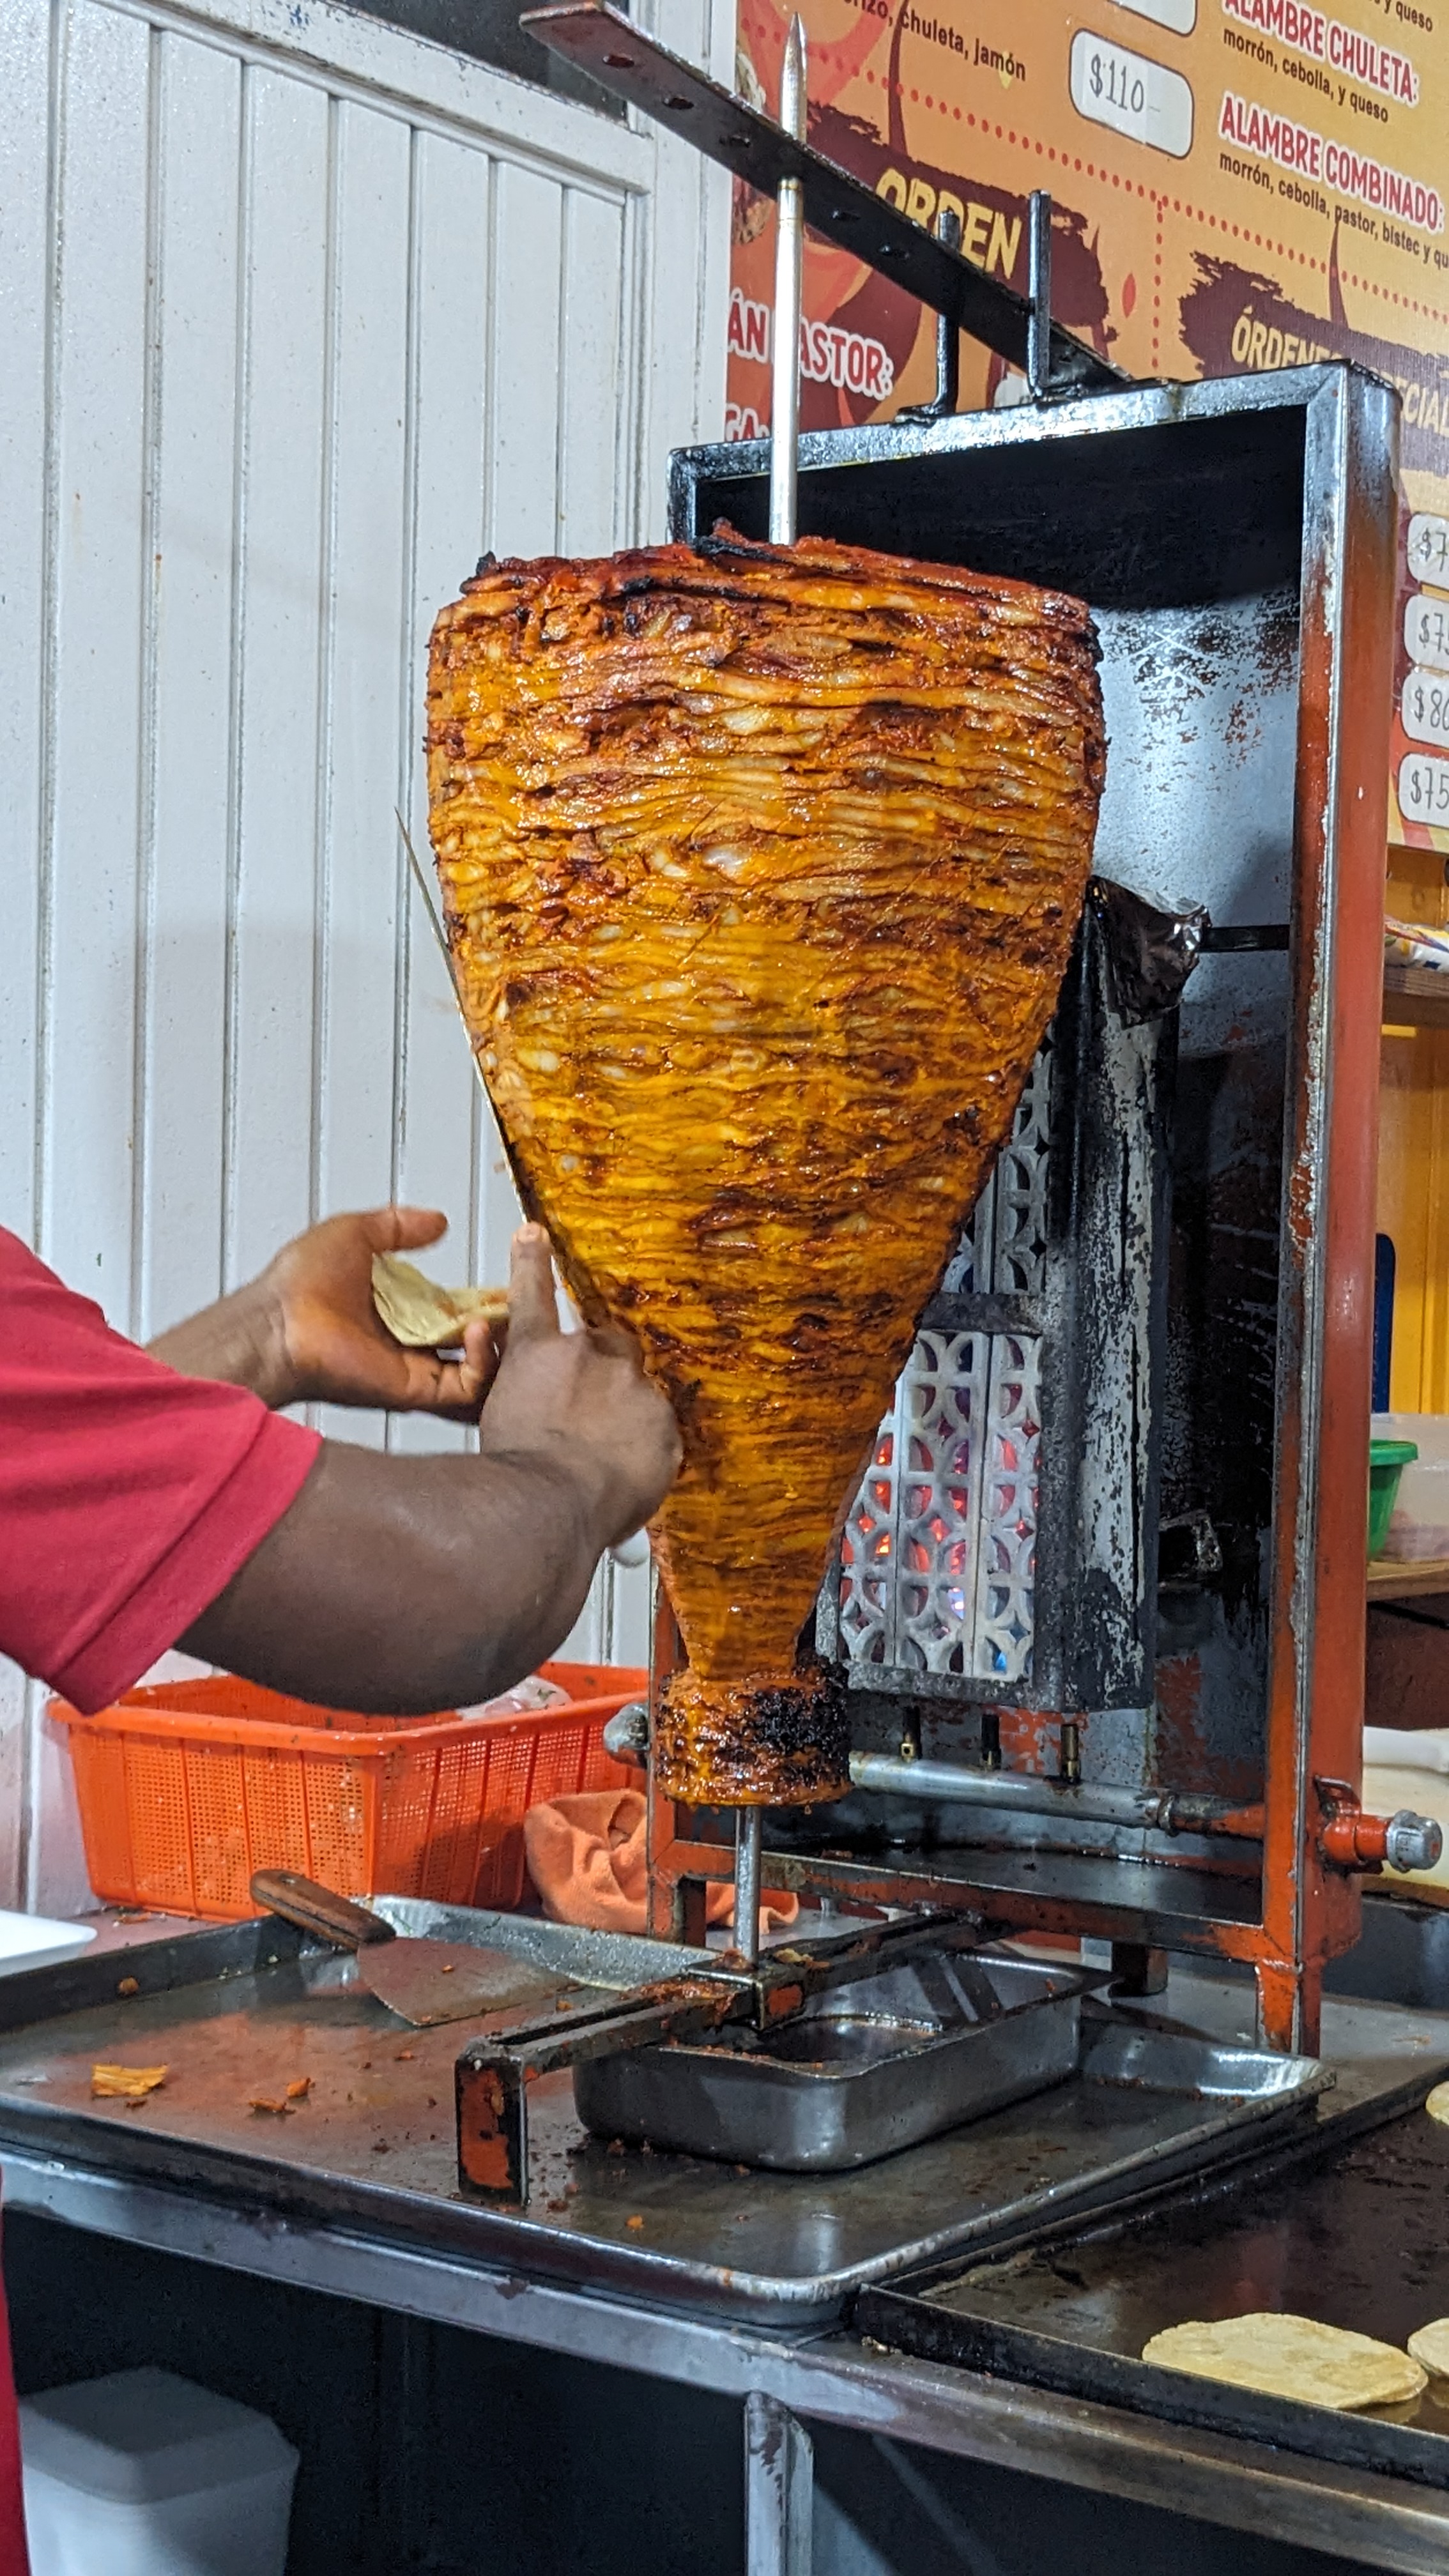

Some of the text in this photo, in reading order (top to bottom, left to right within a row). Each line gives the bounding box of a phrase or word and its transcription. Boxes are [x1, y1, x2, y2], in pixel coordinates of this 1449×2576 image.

[900, 9, 968, 60] chuleta,
[973, 38, 1025, 81] jamón
[1225, 0, 1417, 102] ALAMBRE CHULETA:
[1395, 1, 1432, 33] queso
[1223, 28, 1388, 123] morrón, cebolla, y queso
[1221, 96, 1443, 230] ALAMBRE COMBINADO:
[1220, 152, 1273, 194] morrón,
[1278, 178, 1330, 219] cebolla,
[1335, 204, 1378, 241] pastor,
[1383, 221, 1420, 256] bistec
[1423, 244, 1431, 264] y
[800, 321, 891, 395] ASTOR:
[1419, 612, 1449, 656] $7
